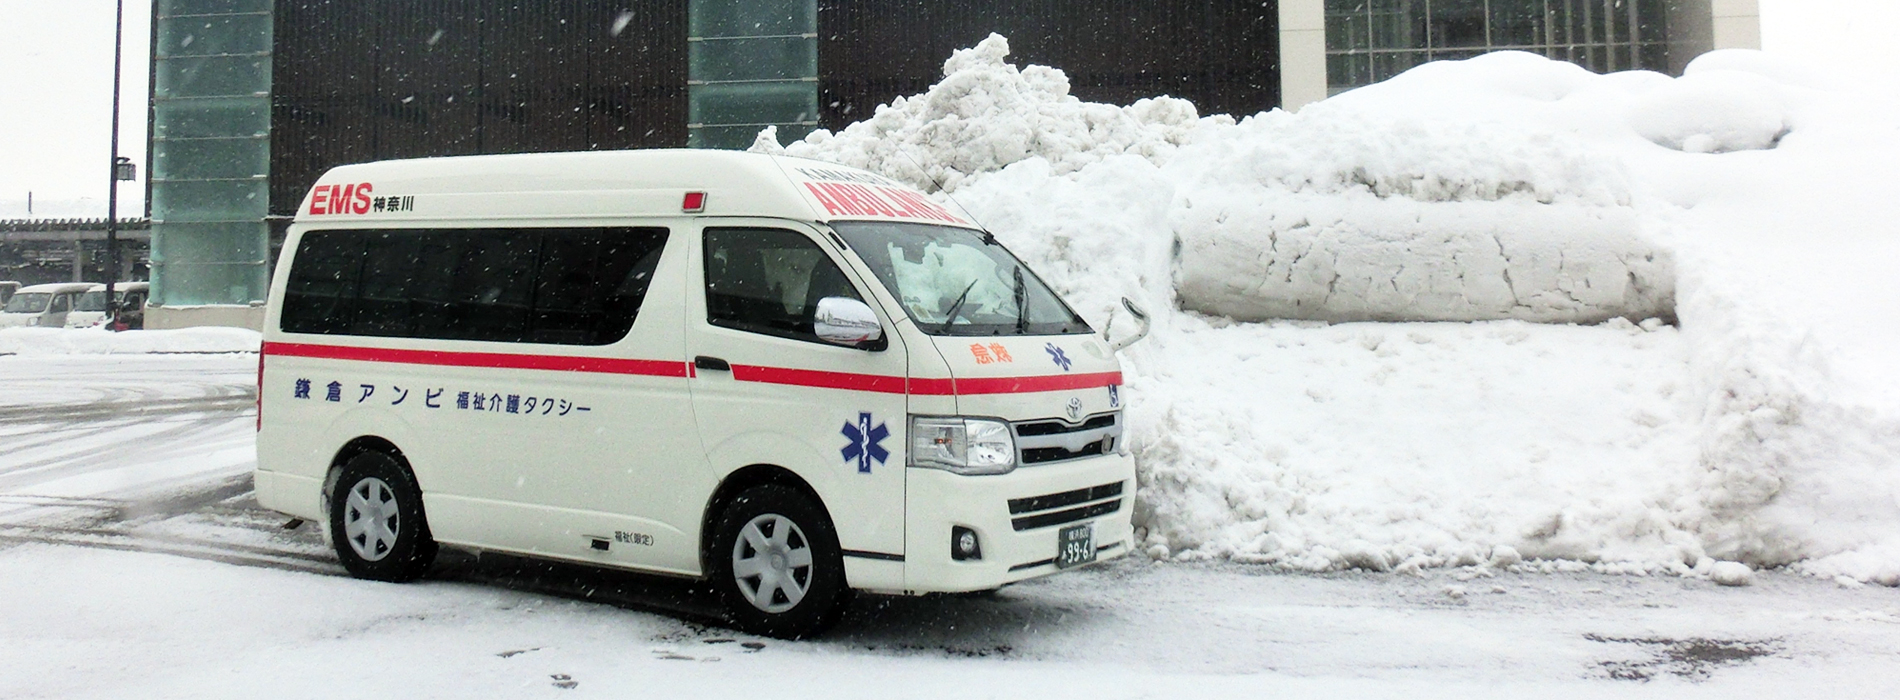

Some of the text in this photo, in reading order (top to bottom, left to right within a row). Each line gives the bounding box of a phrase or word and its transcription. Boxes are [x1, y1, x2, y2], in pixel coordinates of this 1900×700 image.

[309, 182, 414, 215] EMS 神奈川
[803, 181, 969, 225] AMBULANCE
[294, 378, 591, 416] 鎌倉アンビ 福祉介護タクシー
